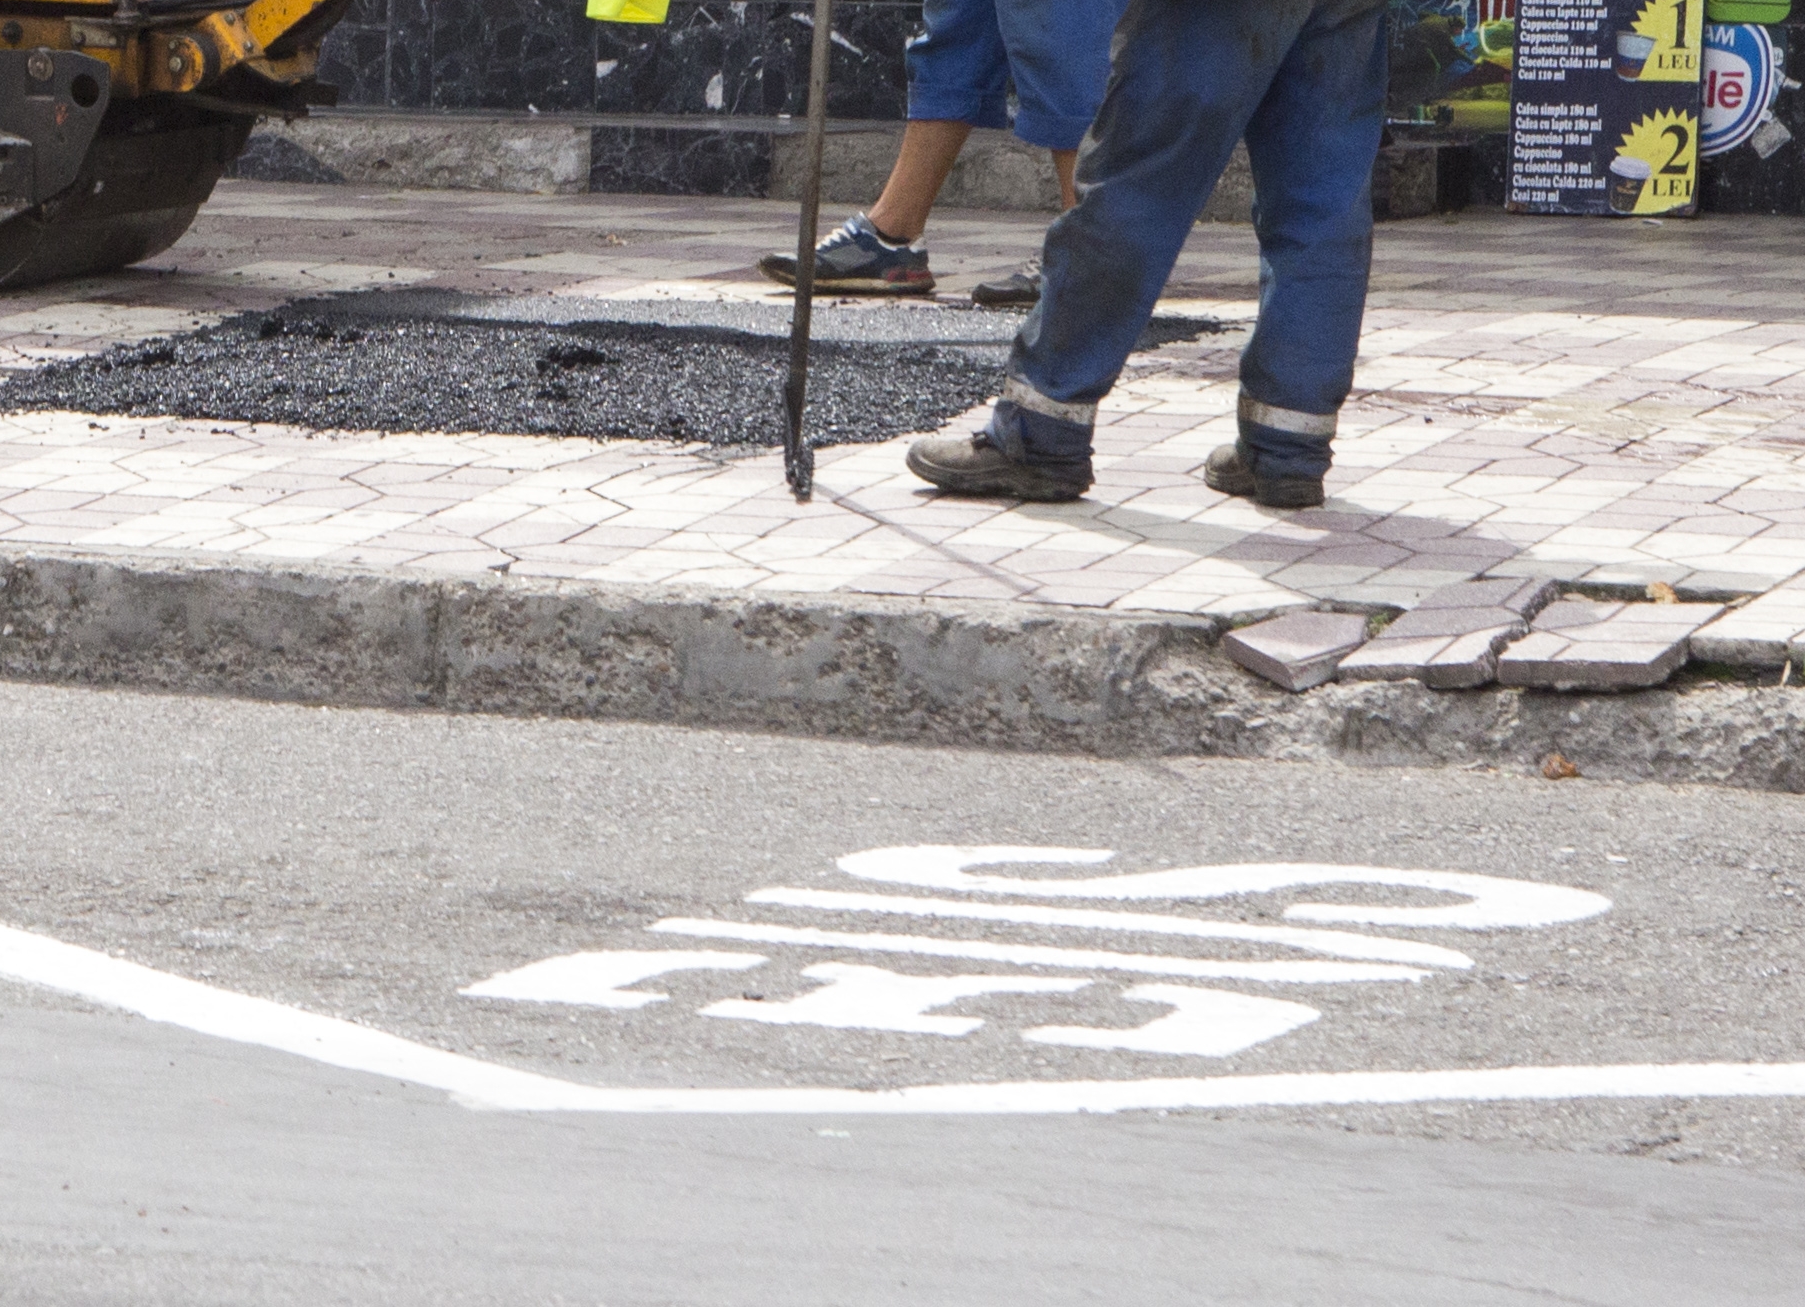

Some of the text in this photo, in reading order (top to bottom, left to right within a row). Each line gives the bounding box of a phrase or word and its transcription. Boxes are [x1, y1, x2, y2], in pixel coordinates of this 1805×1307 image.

[1521, 7, 1607, 20] Cafea cu lapte 110 ml
[1521, 19, 1598, 33] Cappuccino 110 ml
[1520, 31, 1569, 45] Cappuccino
[1519, 45, 1597, 56] cu ciocolata 110 ml
[1519, 57, 1611, 69] Ciocolata Calda 110 ml
[1657, 54, 1698, 69] LEU
[1518, 69, 1565, 80] Ceai 110 ml
[1516, 102, 1539, 117] Cafea
[1540, 102, 1568, 117] simpla
[1586, 102, 1597, 117] ml
[1515, 117, 1538, 132] Cafea
[1551, 117, 1573, 132] lapte
[1590, 117, 1602, 132] ml
[1515, 132, 1563, 146] Cappuccino
[1581, 132, 1592, 146] ml
[1514, 146, 1563, 160] Cappuccino
[1658, 124, 1690, 175] 2
[1525, 160, 1562, 174] ciocolata
[1580, 160, 1591, 174] ml
[1513, 176, 1606, 188] Ciocolata Calda 220 ml
[1652, 179, 1692, 197] LEI
[1512, 189, 1559, 202] Ceai 220 ml
